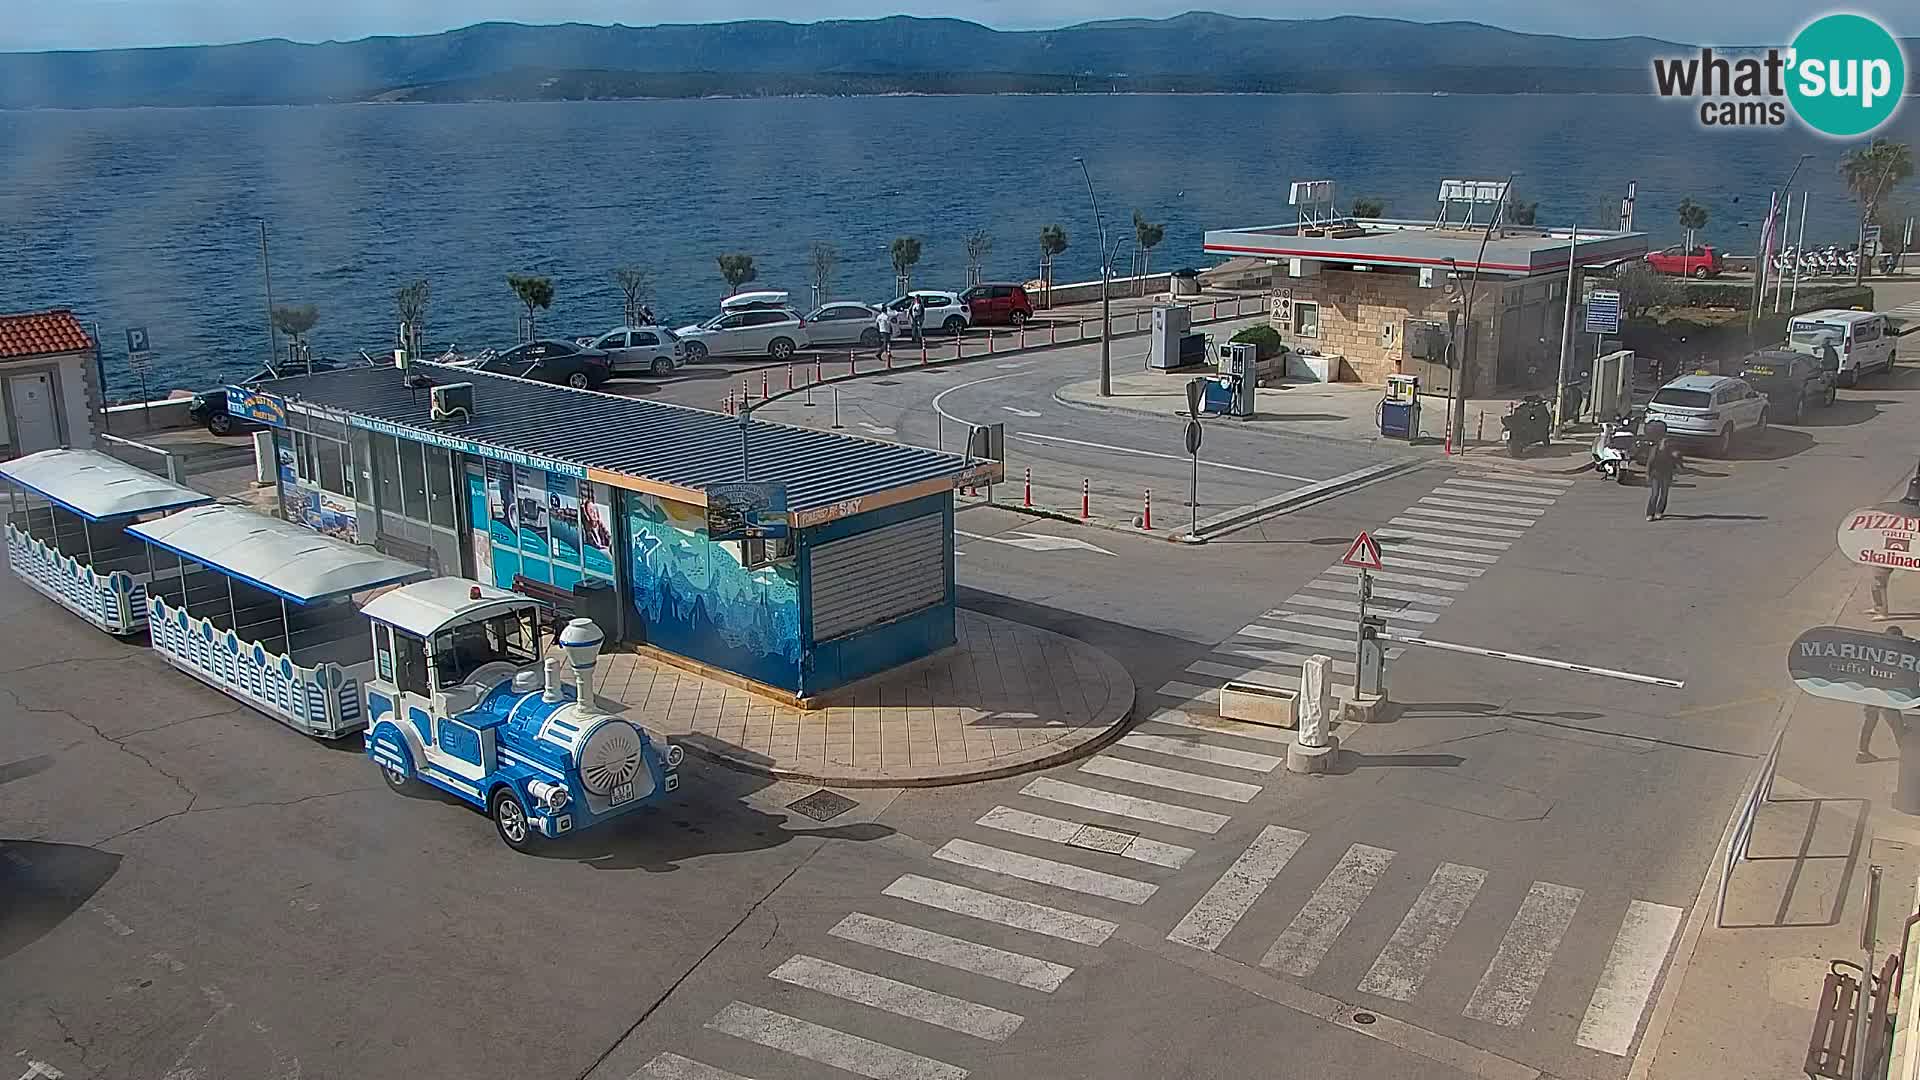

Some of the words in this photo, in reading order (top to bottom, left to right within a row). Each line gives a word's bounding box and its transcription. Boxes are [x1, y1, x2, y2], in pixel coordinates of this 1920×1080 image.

[131, 331, 143, 349] P
[397, 427, 437, 444] AUTOBUSNA
[437, 436, 469, 451] POSTAJA
[479, 445, 494, 457] BUS
[495, 449, 527, 465] STATION
[528, 456, 555, 470] TICKET
[555, 462, 583, 477] OFFICE
[1881, 530, 1917, 540] GRILL
[1870, 665, 1897, 680] bar
